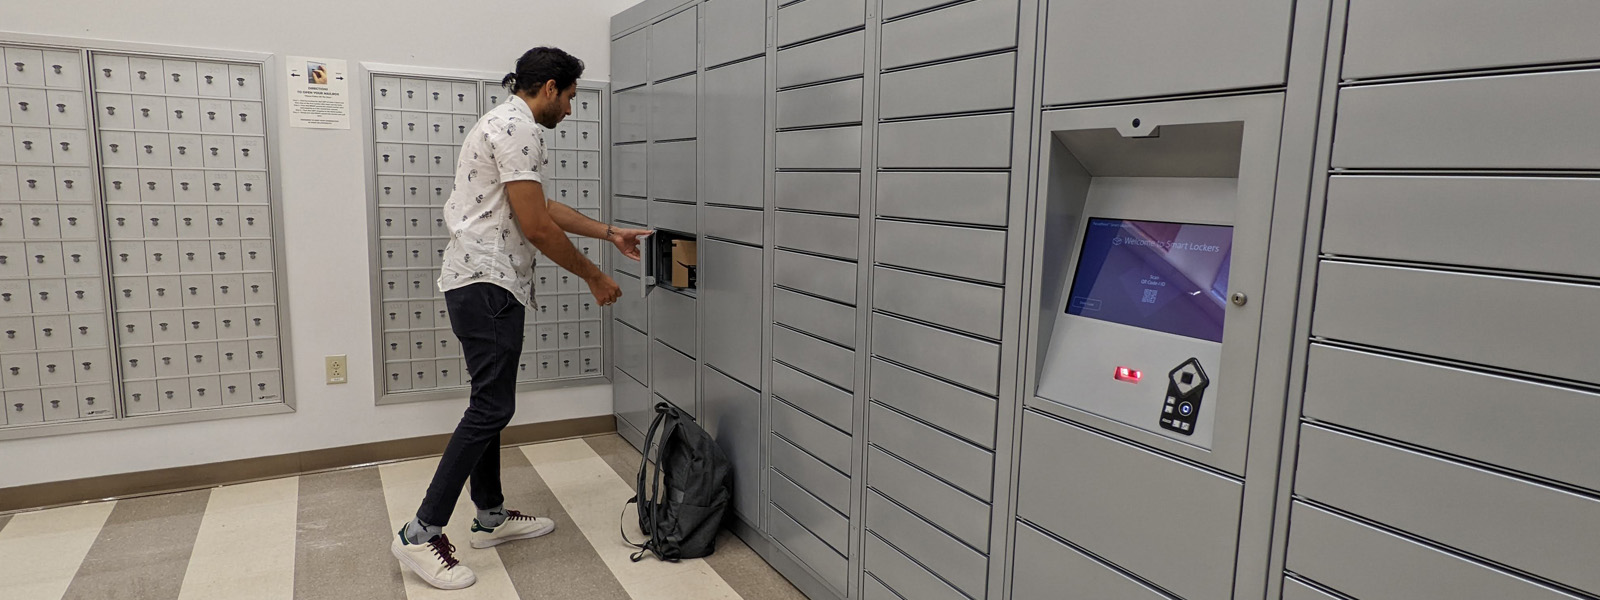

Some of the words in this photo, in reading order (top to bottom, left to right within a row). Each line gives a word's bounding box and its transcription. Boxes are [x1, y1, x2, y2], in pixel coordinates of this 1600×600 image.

[1124, 237, 1156, 247] Welcome
[1166, 241, 1188, 250] Smart
[1190, 242, 1220, 253] Lockers
